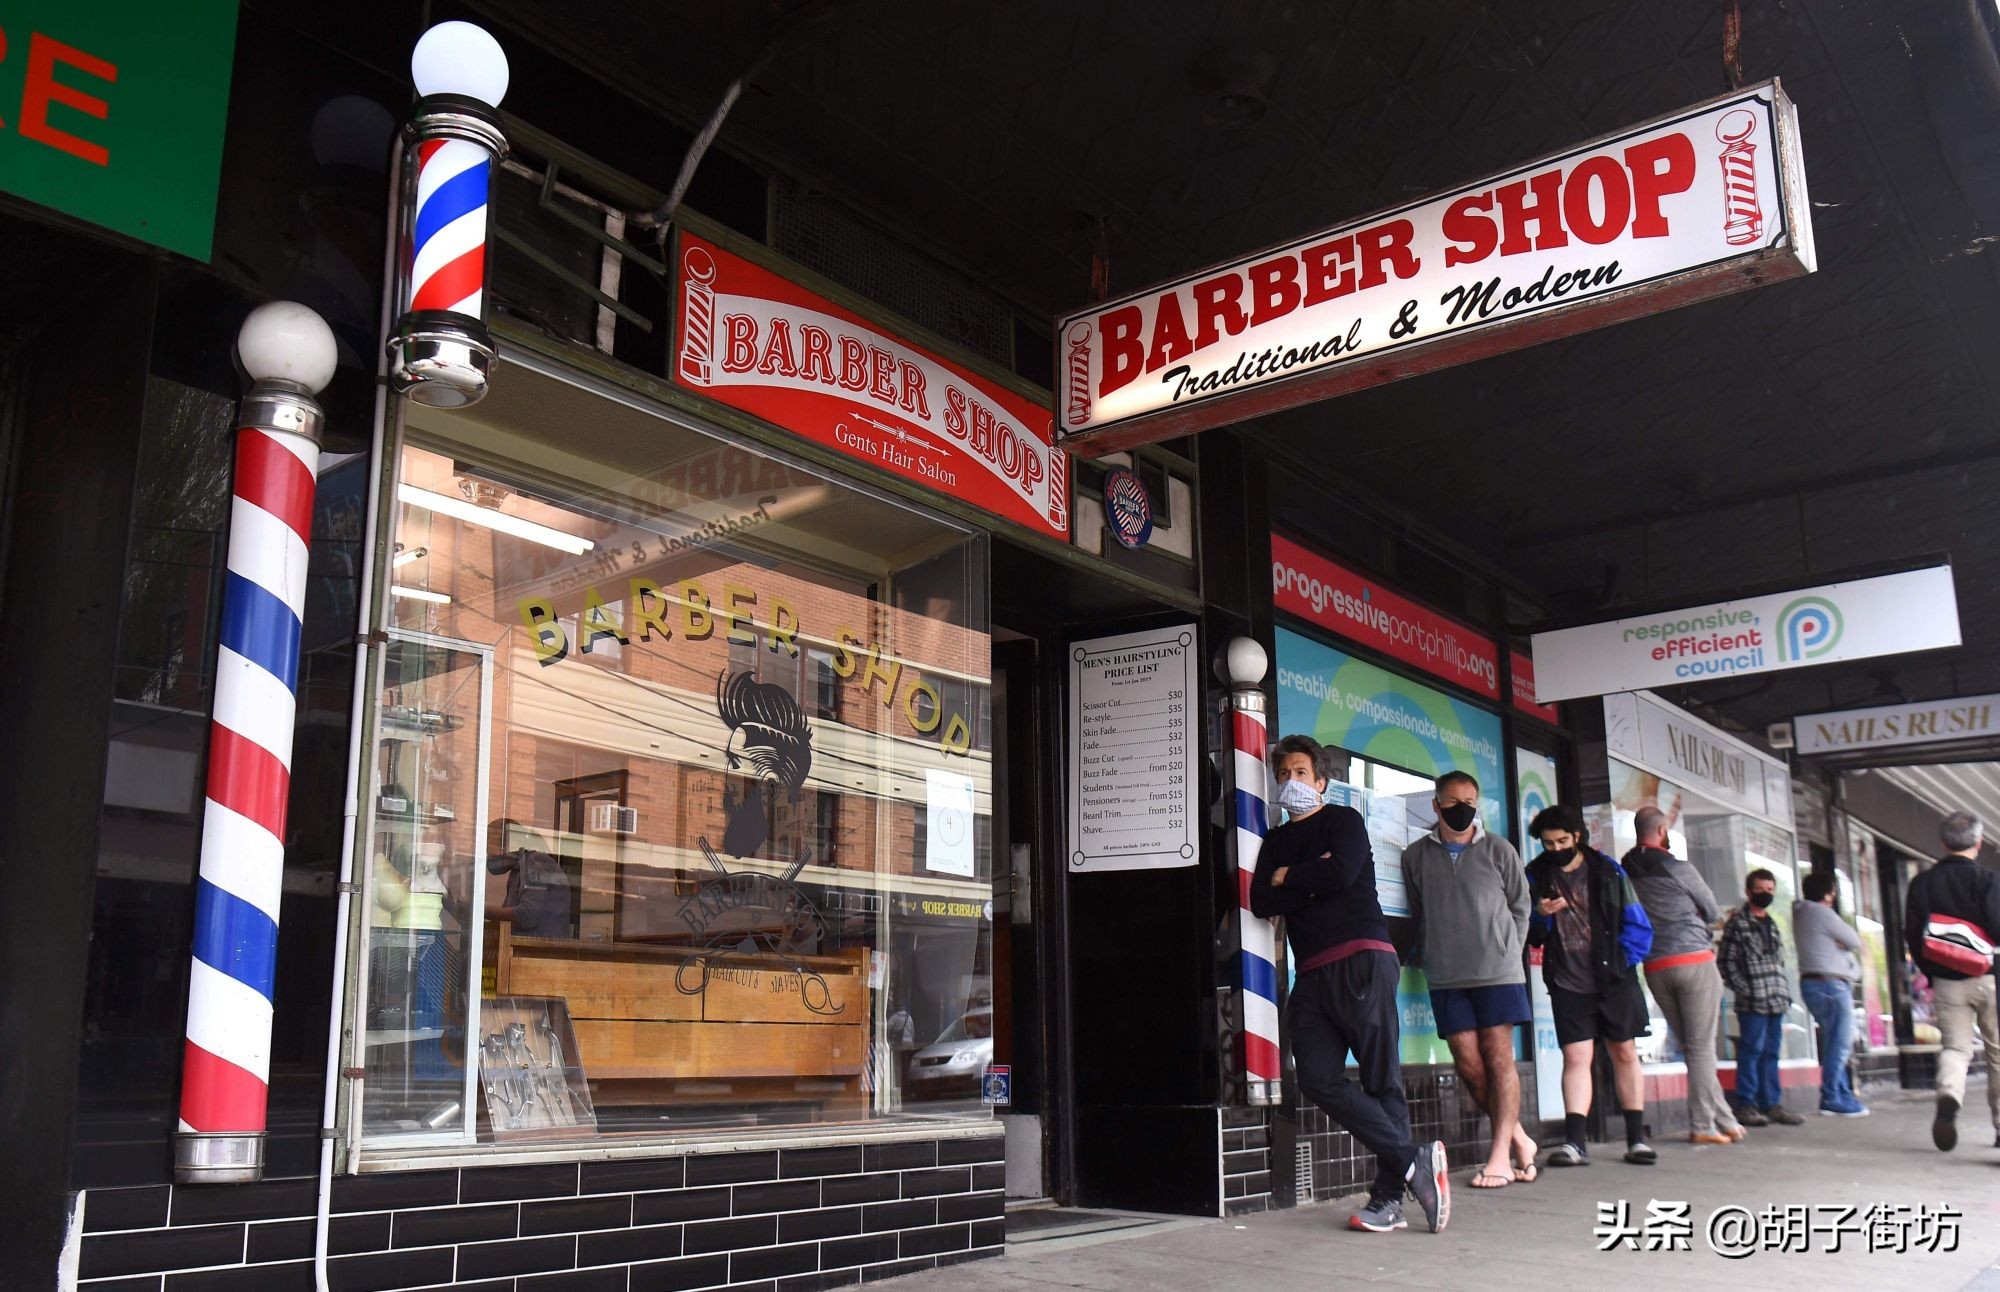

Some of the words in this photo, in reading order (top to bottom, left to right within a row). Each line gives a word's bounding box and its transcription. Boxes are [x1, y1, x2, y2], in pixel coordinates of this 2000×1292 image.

[0, 25, 118, 167] E
[1099, 218, 1421, 399] BARBER
[1441, 133, 1696, 268] SHOP
[1162, 318, 1362, 401] Traditional
[1389, 300, 1418, 339] &
[1440, 260, 1622, 325] Modern
[722, 314, 932, 420] BARBER
[943, 384, 1043, 495] SHOP
[835, 423, 877, 456] Gents
[881, 441, 914, 470] Hair
[918, 456, 956, 486] Salon
[1273, 561, 1496, 690] progressiveportphillip.org
[1623, 609, 1760, 643] responsive,
[1082, 657, 1111, 669] MEN'S
[1114, 646, 1181, 665] HAIRSTYLING
[1651, 629, 1762, 661] efficient
[518, 577, 799, 668] BARBER
[830, 624, 971, 760] SHOP
[1104, 666, 1134, 678] PRICE
[1137, 663, 1160, 674] LIST
[1675, 648, 1764, 677] council
[1082, 701, 1106, 711] Scissor
[1108, 699, 1120, 707] Cut
[1168, 690, 1183, 700] $30
[1083, 713, 1111, 724] Re-style
[1168, 704, 1182, 714] $35
[1278, 667, 1344, 710] creative,
[1346, 691, 1437, 741] compassionate
[1440, 726, 1497, 766] community
[1814, 714, 1900, 747] NAILS
[1906, 704, 1991, 737] RUSH
[1082, 728, 1098, 737] Skin
[1100, 726, 1117, 735] Fade
[1168, 718, 1182, 728] $35
[1083, 741, 1100, 750] Fade
[1168, 731, 1182, 742] $32
[1083, 756, 1100, 765] Buzz
[1101, 754, 1114, 763] Cut
[1168, 746, 1183, 756] $15
[1667, 723, 1709, 779] NAILS
[1711, 745, 1745, 794] RUSH
[1083, 770, 1100, 779] Buzz
[1101, 768, 1118, 777] Fade
[1149, 763, 1167, 772] from
[1168, 761, 1183, 771] $20
[1082, 783, 1114, 793] Students
[1168, 775, 1183, 785] $28
[1083, 796, 1120, 806] Pensioners
[1149, 792, 1167, 801] from
[1168, 790, 1183, 799] $15
[1082, 811, 1102, 820] Beard
[1104, 810, 1121, 819] Trim
[1148, 806, 1167, 815] from
[1168, 804, 1183, 815] $15
[1082, 826, 1103, 835] Shave
[1168, 819, 1183, 829] $32
[1404, 1003, 1435, 1027] effic
